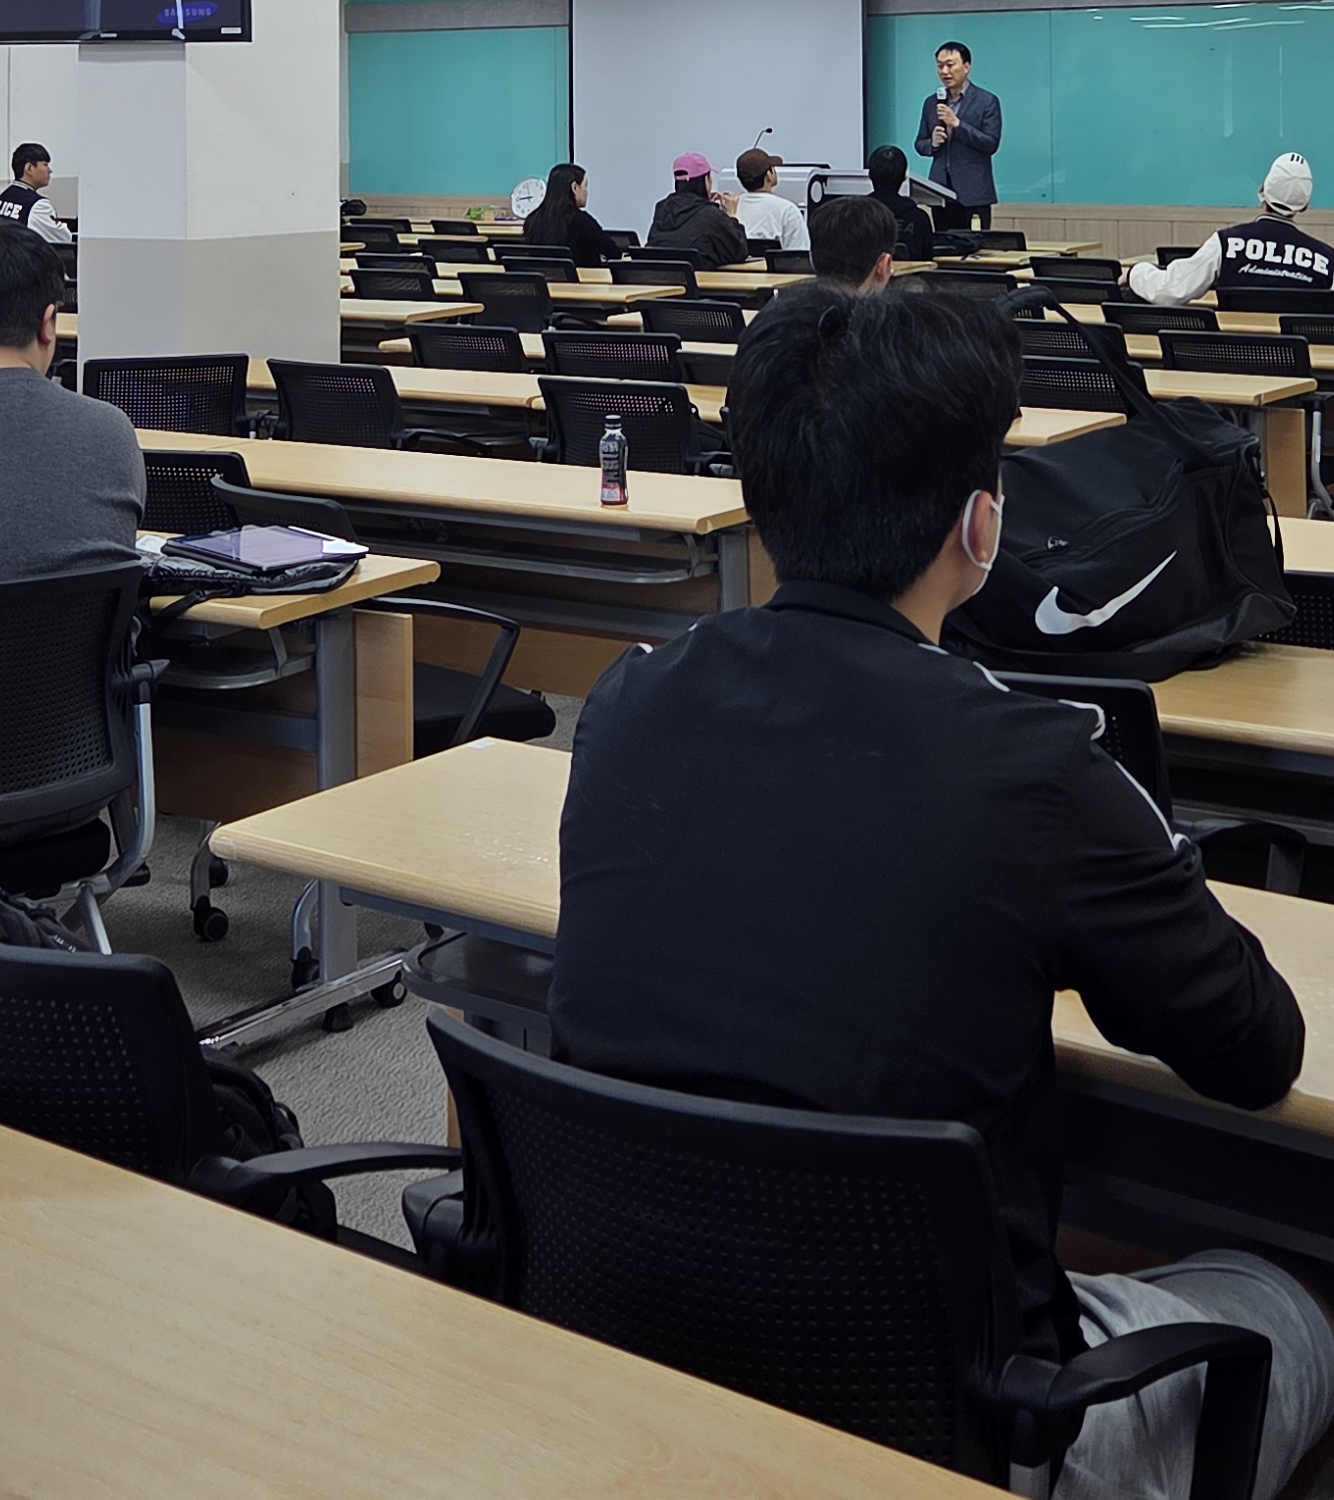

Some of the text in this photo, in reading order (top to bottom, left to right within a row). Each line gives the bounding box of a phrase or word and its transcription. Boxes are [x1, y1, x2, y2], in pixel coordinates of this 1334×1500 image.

[163, 7, 212, 17] SASUNG
[1226, 237, 1329, 276] POLICE
[1238, 263, 1314, 283] Administration
